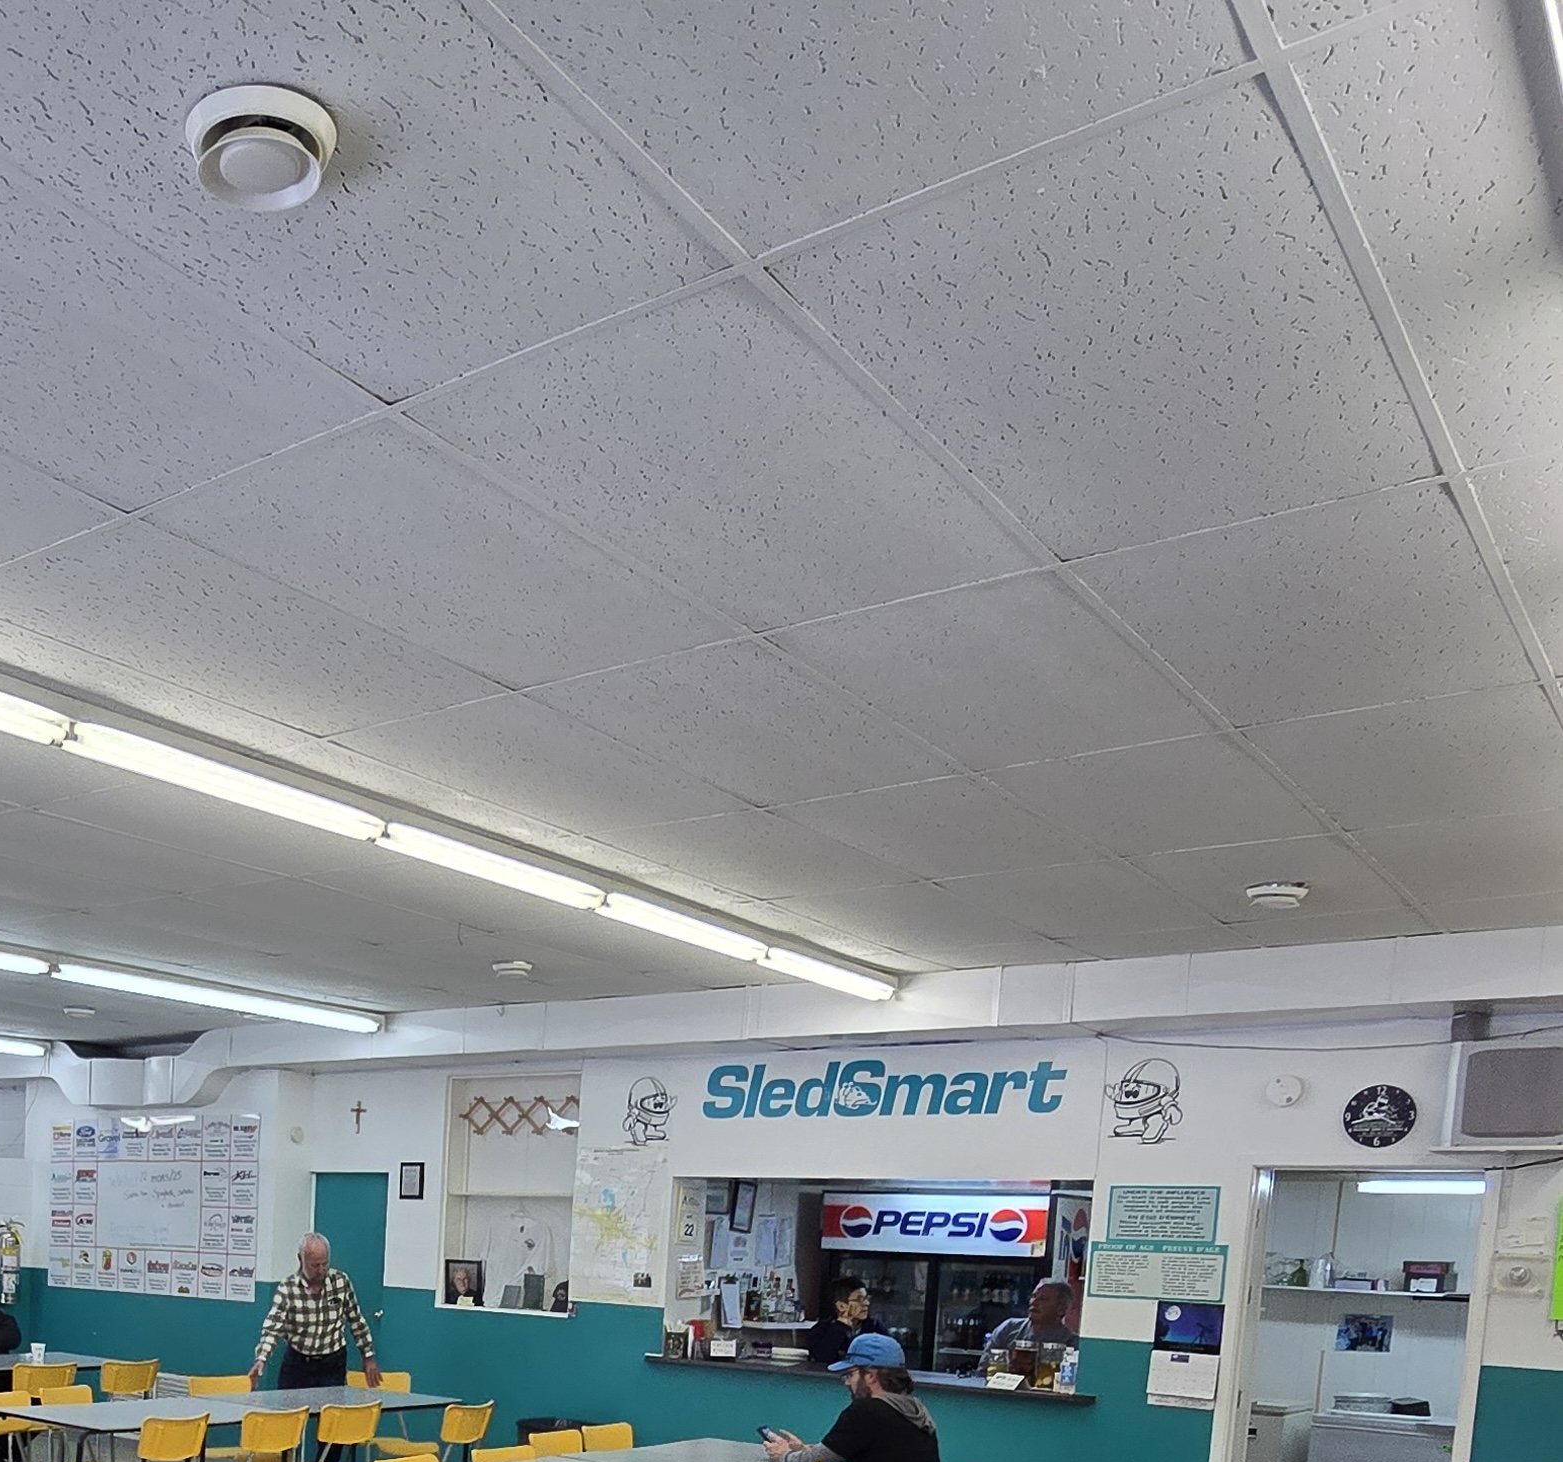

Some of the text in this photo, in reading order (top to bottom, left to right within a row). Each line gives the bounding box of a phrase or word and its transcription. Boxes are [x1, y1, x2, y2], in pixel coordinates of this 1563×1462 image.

[702, 1059, 1068, 1119] SledSmart
[684, 1223, 694, 1237] 22
[872, 1210, 989, 1238] PEPSI
